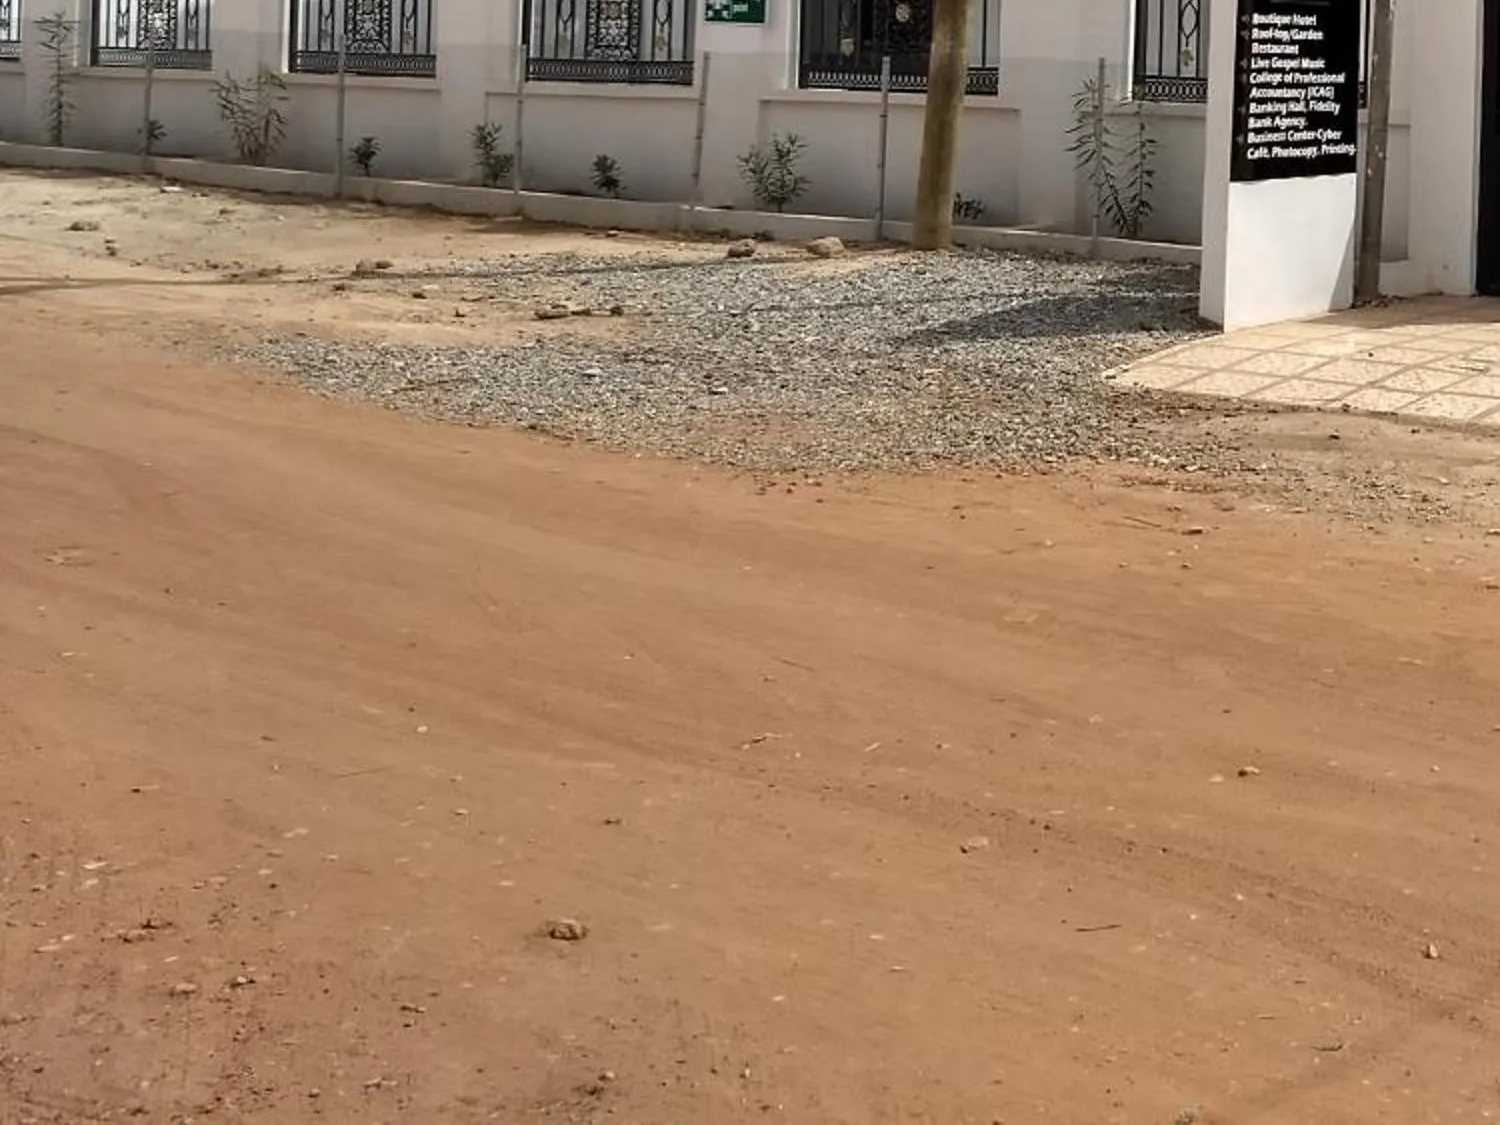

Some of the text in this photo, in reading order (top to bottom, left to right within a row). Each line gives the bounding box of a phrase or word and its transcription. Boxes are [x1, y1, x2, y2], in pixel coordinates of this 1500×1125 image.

[1250, 57, 1270, 69] Live
[1301, 58, 1326, 69] Music
[1249, 72, 1282, 85] College
[1283, 73, 1293, 83] of
[1249, 102, 1287, 115] Banking
[1309, 101, 1340, 115] Fidelity
[1248, 117, 1273, 129] Bank
